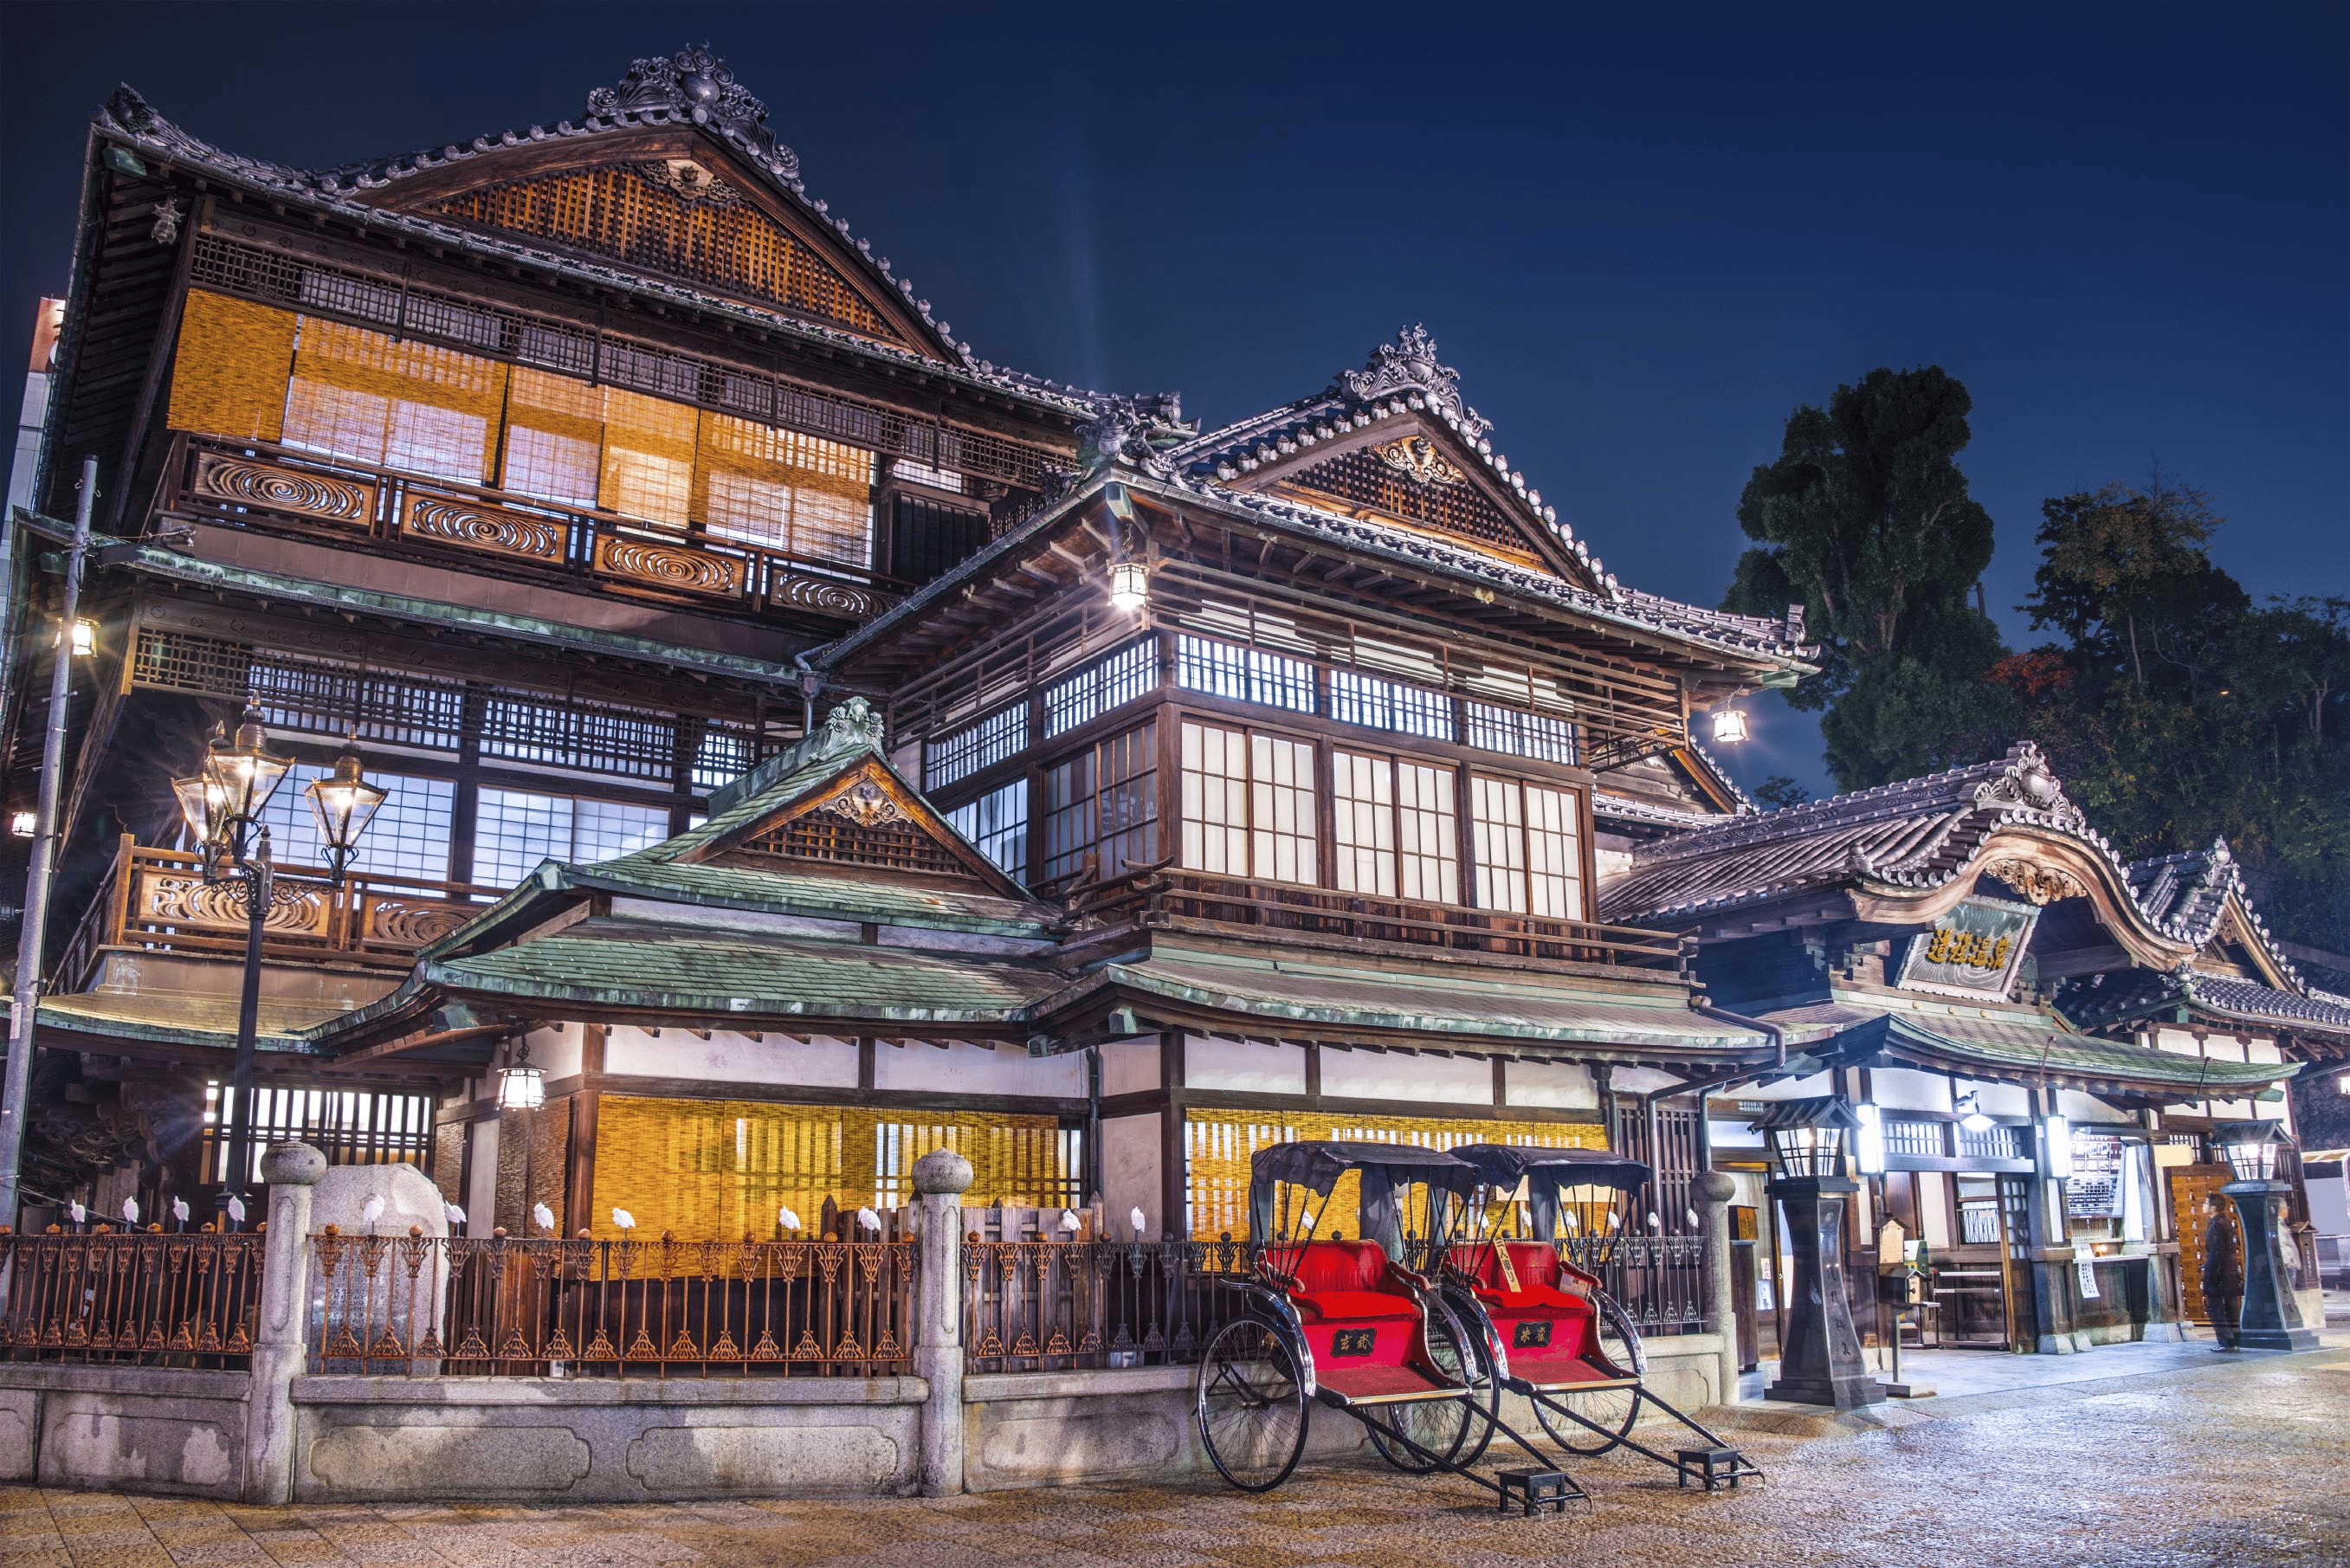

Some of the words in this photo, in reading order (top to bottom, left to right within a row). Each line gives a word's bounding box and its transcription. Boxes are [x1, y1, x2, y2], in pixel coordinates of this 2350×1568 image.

[1927, 928, 2010, 971] 道後温泉
[1340, 1333, 1373, 1351] 玄武
[1520, 1326, 1546, 1344] 朱雀
